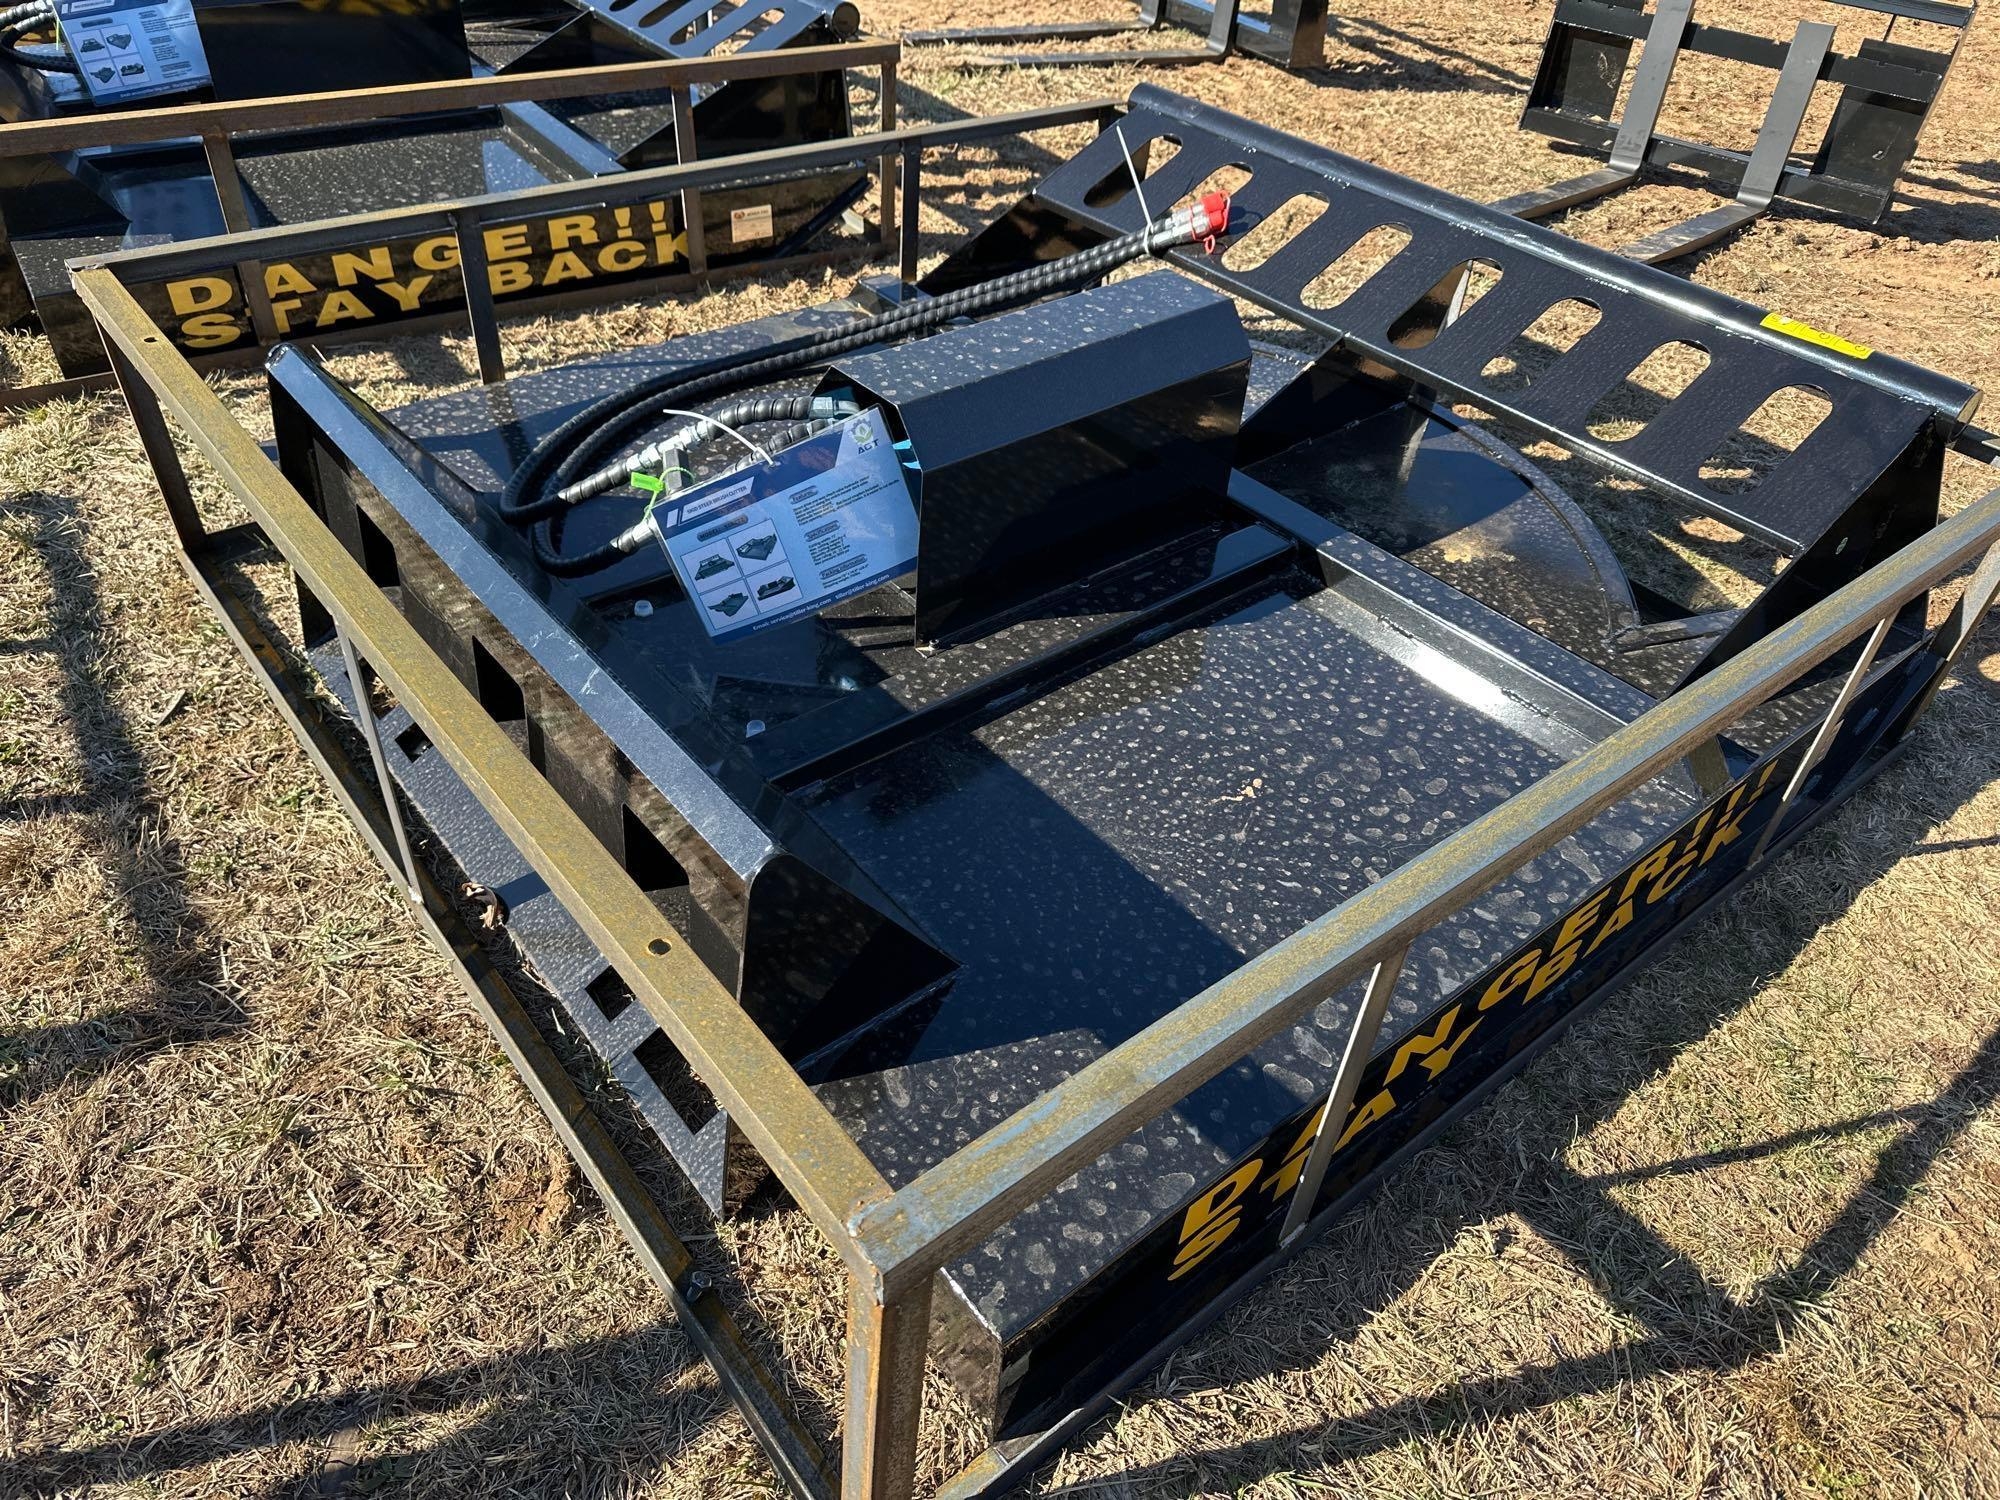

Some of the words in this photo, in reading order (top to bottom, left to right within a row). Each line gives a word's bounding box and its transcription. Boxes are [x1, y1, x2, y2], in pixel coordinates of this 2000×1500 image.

[181, 275, 434, 348] STAY
[487, 231, 689, 295] BACK
[728, 486, 747, 497] CUTTER
[1167, 1015, 1485, 1281] STAY
[1523, 800, 1758, 1005] BACK
